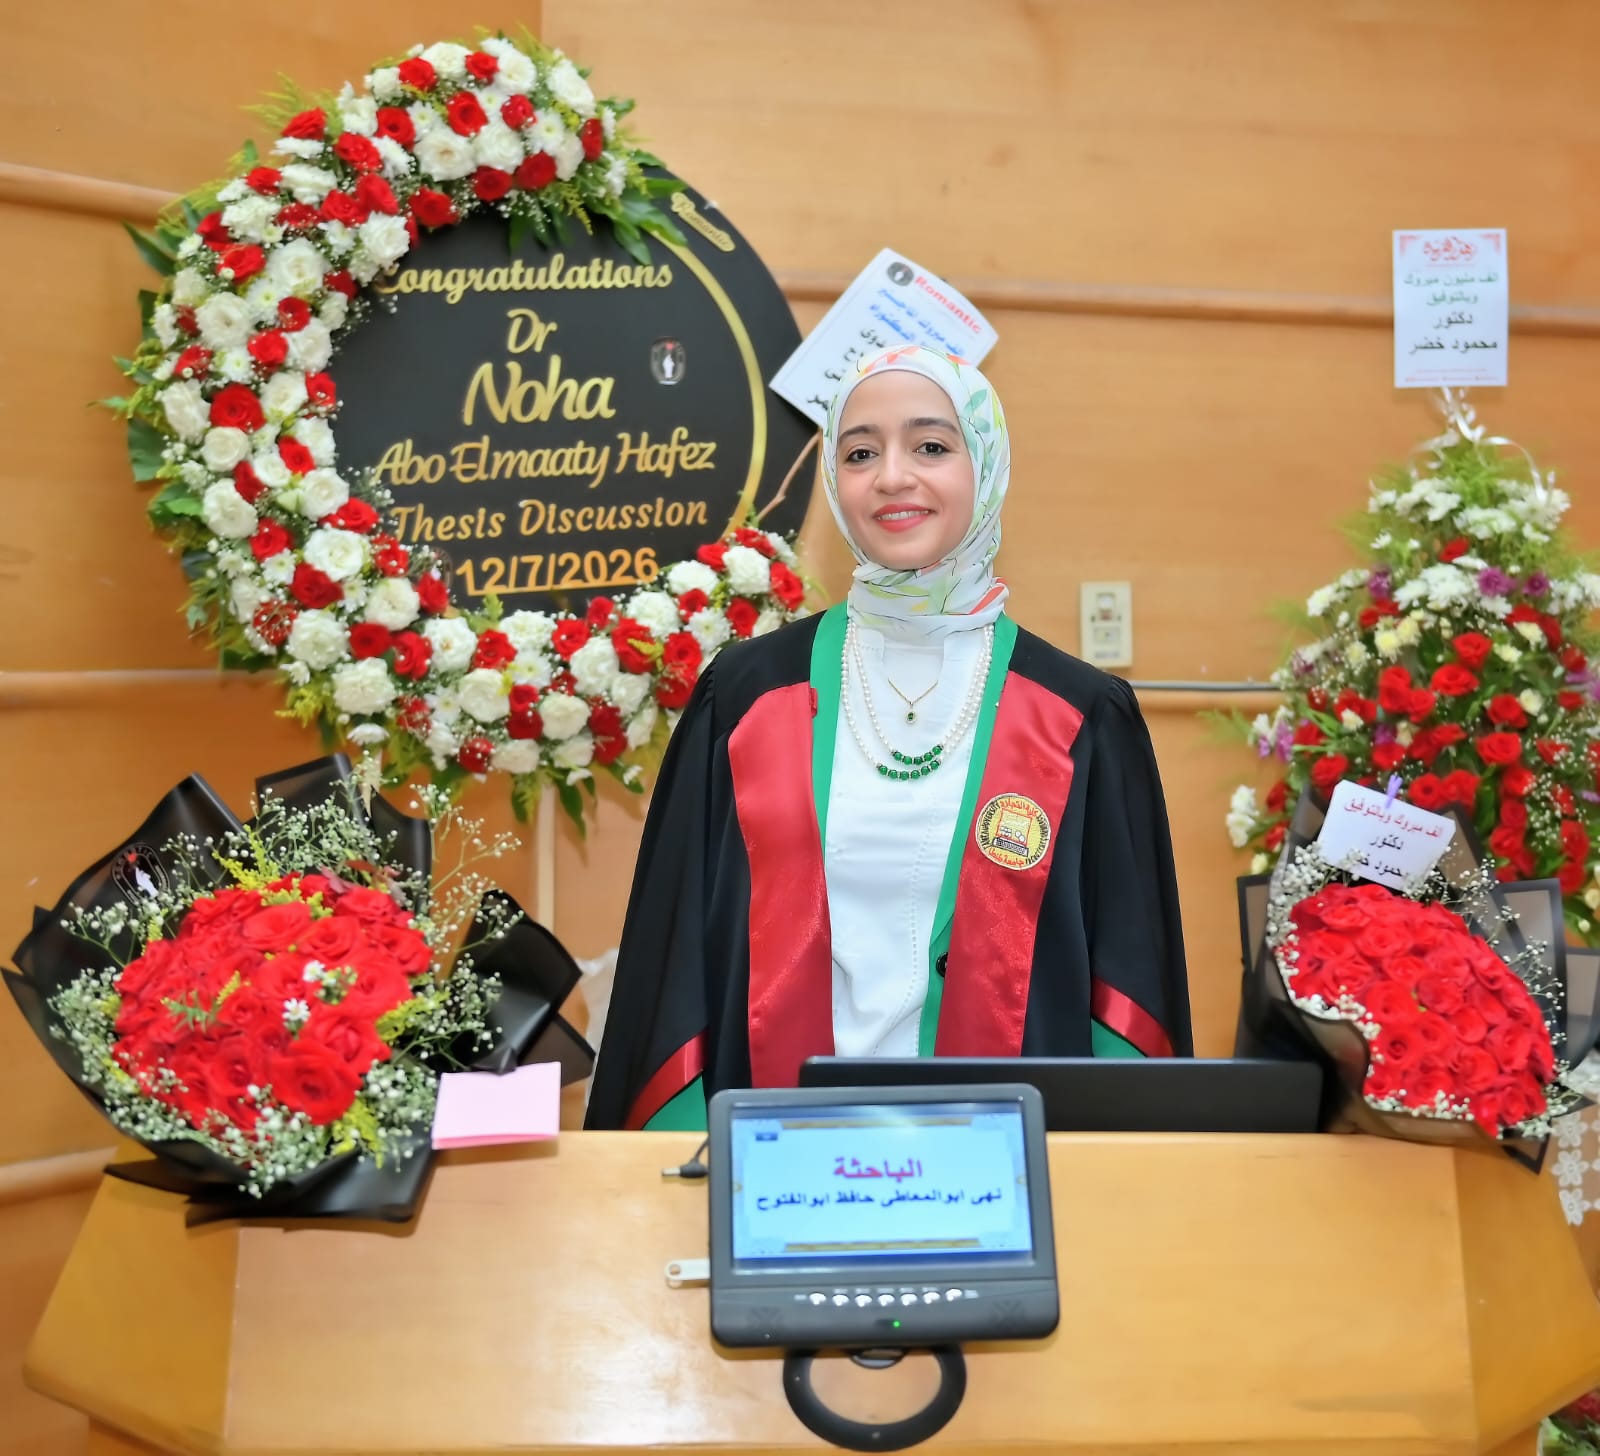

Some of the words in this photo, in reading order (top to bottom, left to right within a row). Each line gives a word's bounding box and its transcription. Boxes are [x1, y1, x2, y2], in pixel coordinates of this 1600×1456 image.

[914, 275, 981, 334] Romantic
[1432, 311, 1473, 330] دكتور
[507, 308, 557, 353] Dr
[1407, 336, 1445, 355] خضر
[1450, 338, 1498, 355] محمود
[463, 354, 616, 425] Noha
[373, 439, 446, 485] Abo
[450, 435, 609, 488] Elmaaty
[616, 427, 716, 478] Hafez
[391, 503, 505, 542] Thesis
[520, 497, 707, 536] Discussion
[456, 547, 658, 596] 12/7/2026
[1369, 833, 1405, 850] دكتور
[833, 1155, 923, 1183] الباحثة
[834, 1190, 875, 1205] حافظ
